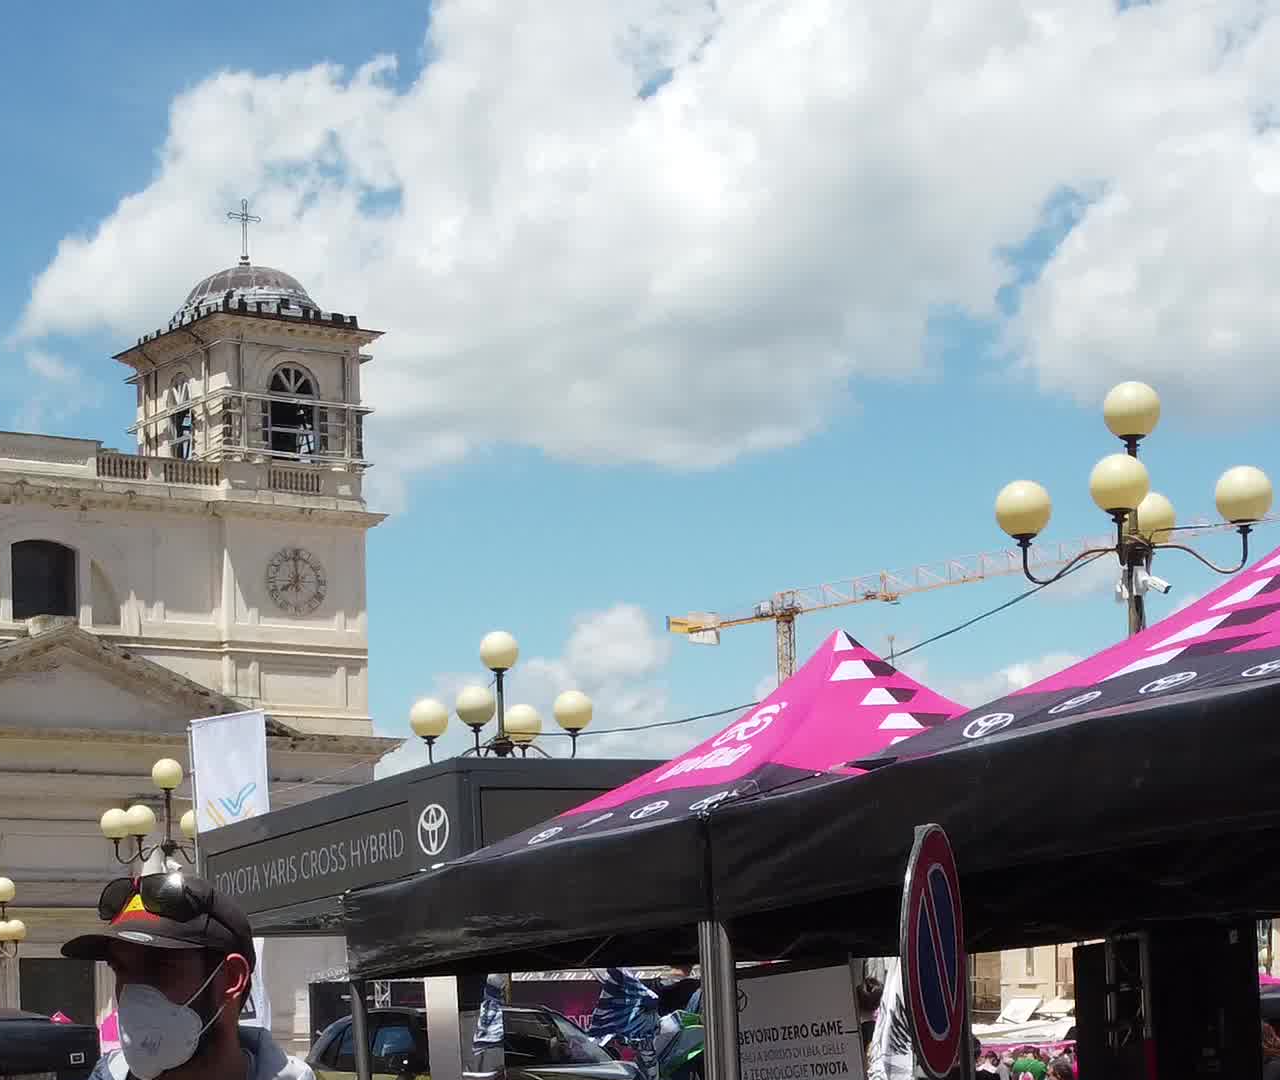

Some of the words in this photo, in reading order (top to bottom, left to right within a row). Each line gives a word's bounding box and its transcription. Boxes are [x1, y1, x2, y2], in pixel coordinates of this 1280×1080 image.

[214, 866, 261, 897] TOYOTA
[262, 855, 298, 889] YARIS
[300, 842, 346, 880] CROSS
[350, 828, 405, 866] HYBRID
[738, 1027, 780, 1046] BEYOND
[780, 1023, 808, 1041] ZERO
[810, 1019, 844, 1037] GAME
[751, 1063, 808, 1080] TECNOLOGIE
[810, 1061, 848, 1077] TOYOTA
